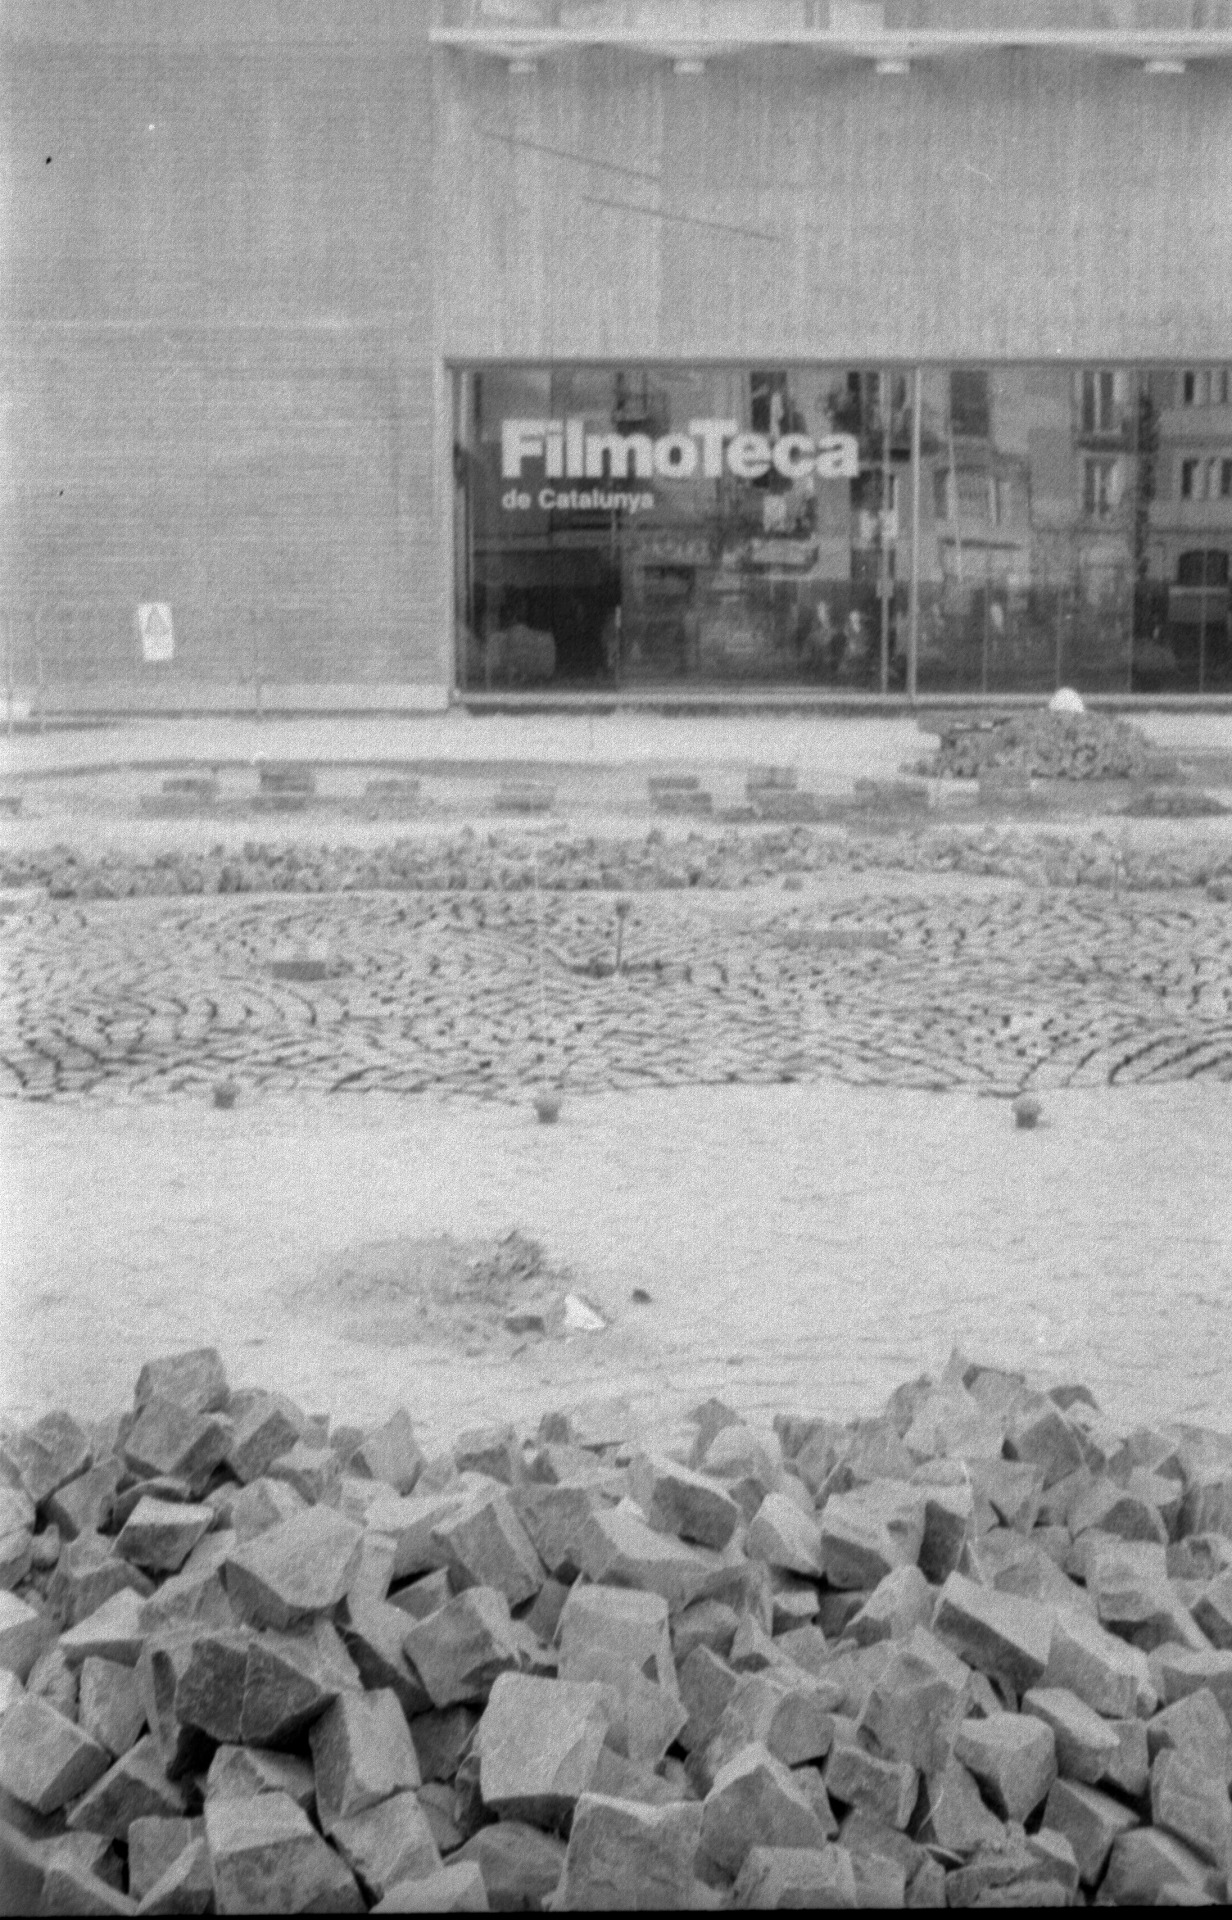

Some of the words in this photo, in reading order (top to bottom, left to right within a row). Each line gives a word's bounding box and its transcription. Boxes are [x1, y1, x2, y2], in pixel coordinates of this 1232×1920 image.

[502, 419, 859, 478] FilmoTeca
[502, 489, 531, 510] de
[538, 488, 654, 513] Catalunya
